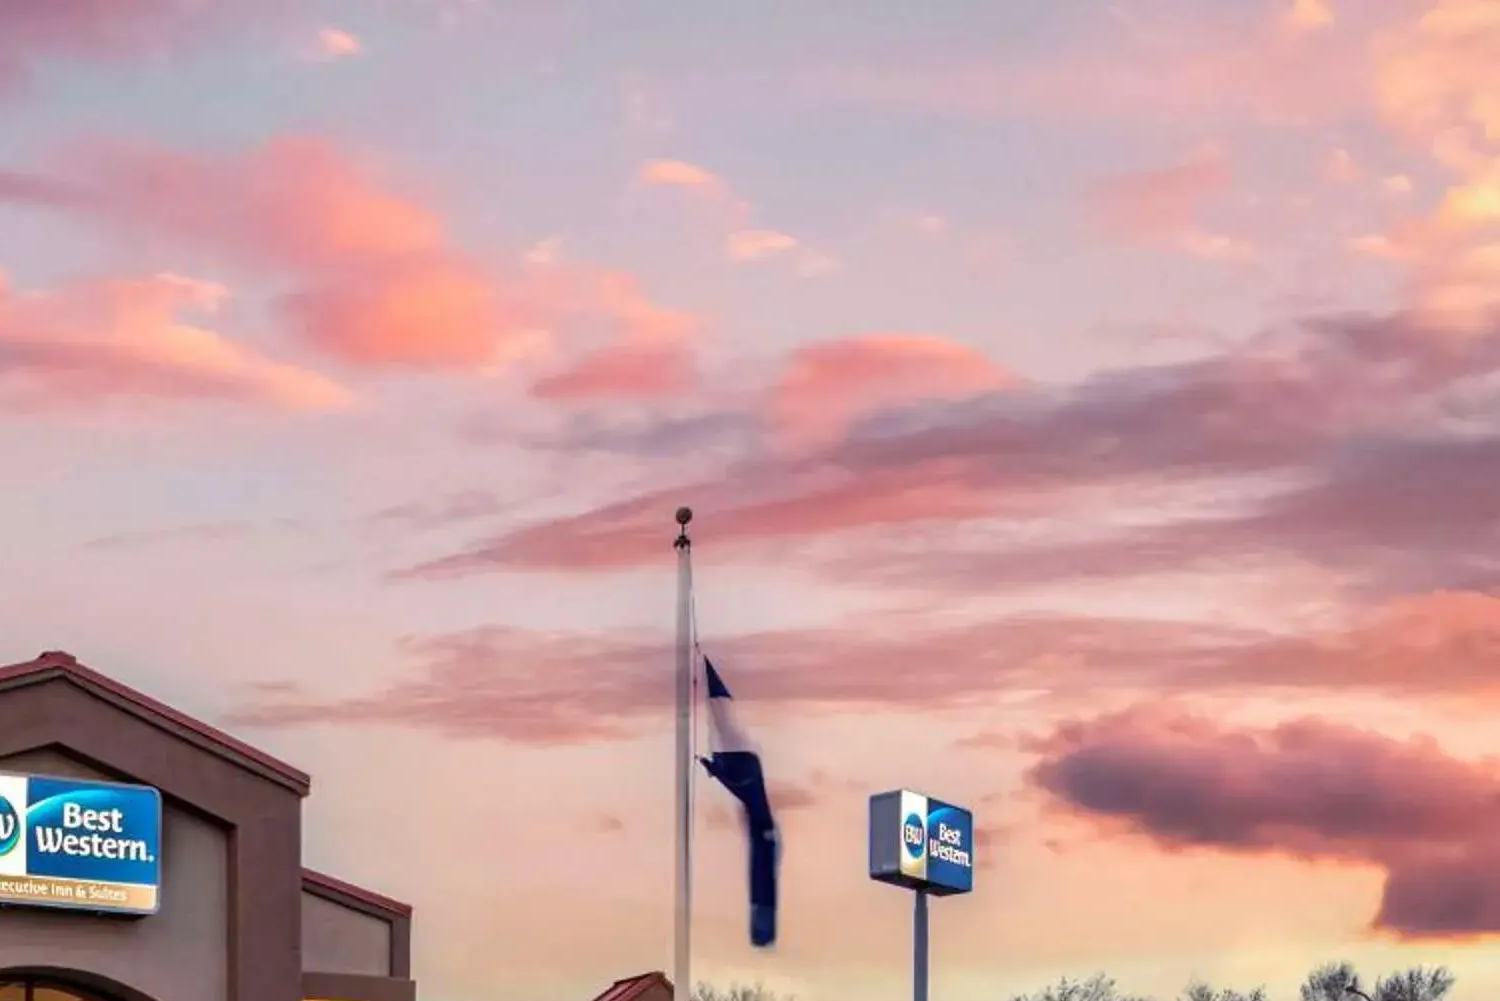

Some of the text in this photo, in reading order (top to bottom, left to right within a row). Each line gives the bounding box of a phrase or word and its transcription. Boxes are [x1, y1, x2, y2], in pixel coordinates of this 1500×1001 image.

[63, 801, 123, 833] Best
[939, 822, 961, 846] Best
[51, 883, 73, 897] Inn
[75, 886, 86, 898] &
[88, 885, 128, 901] Suites
